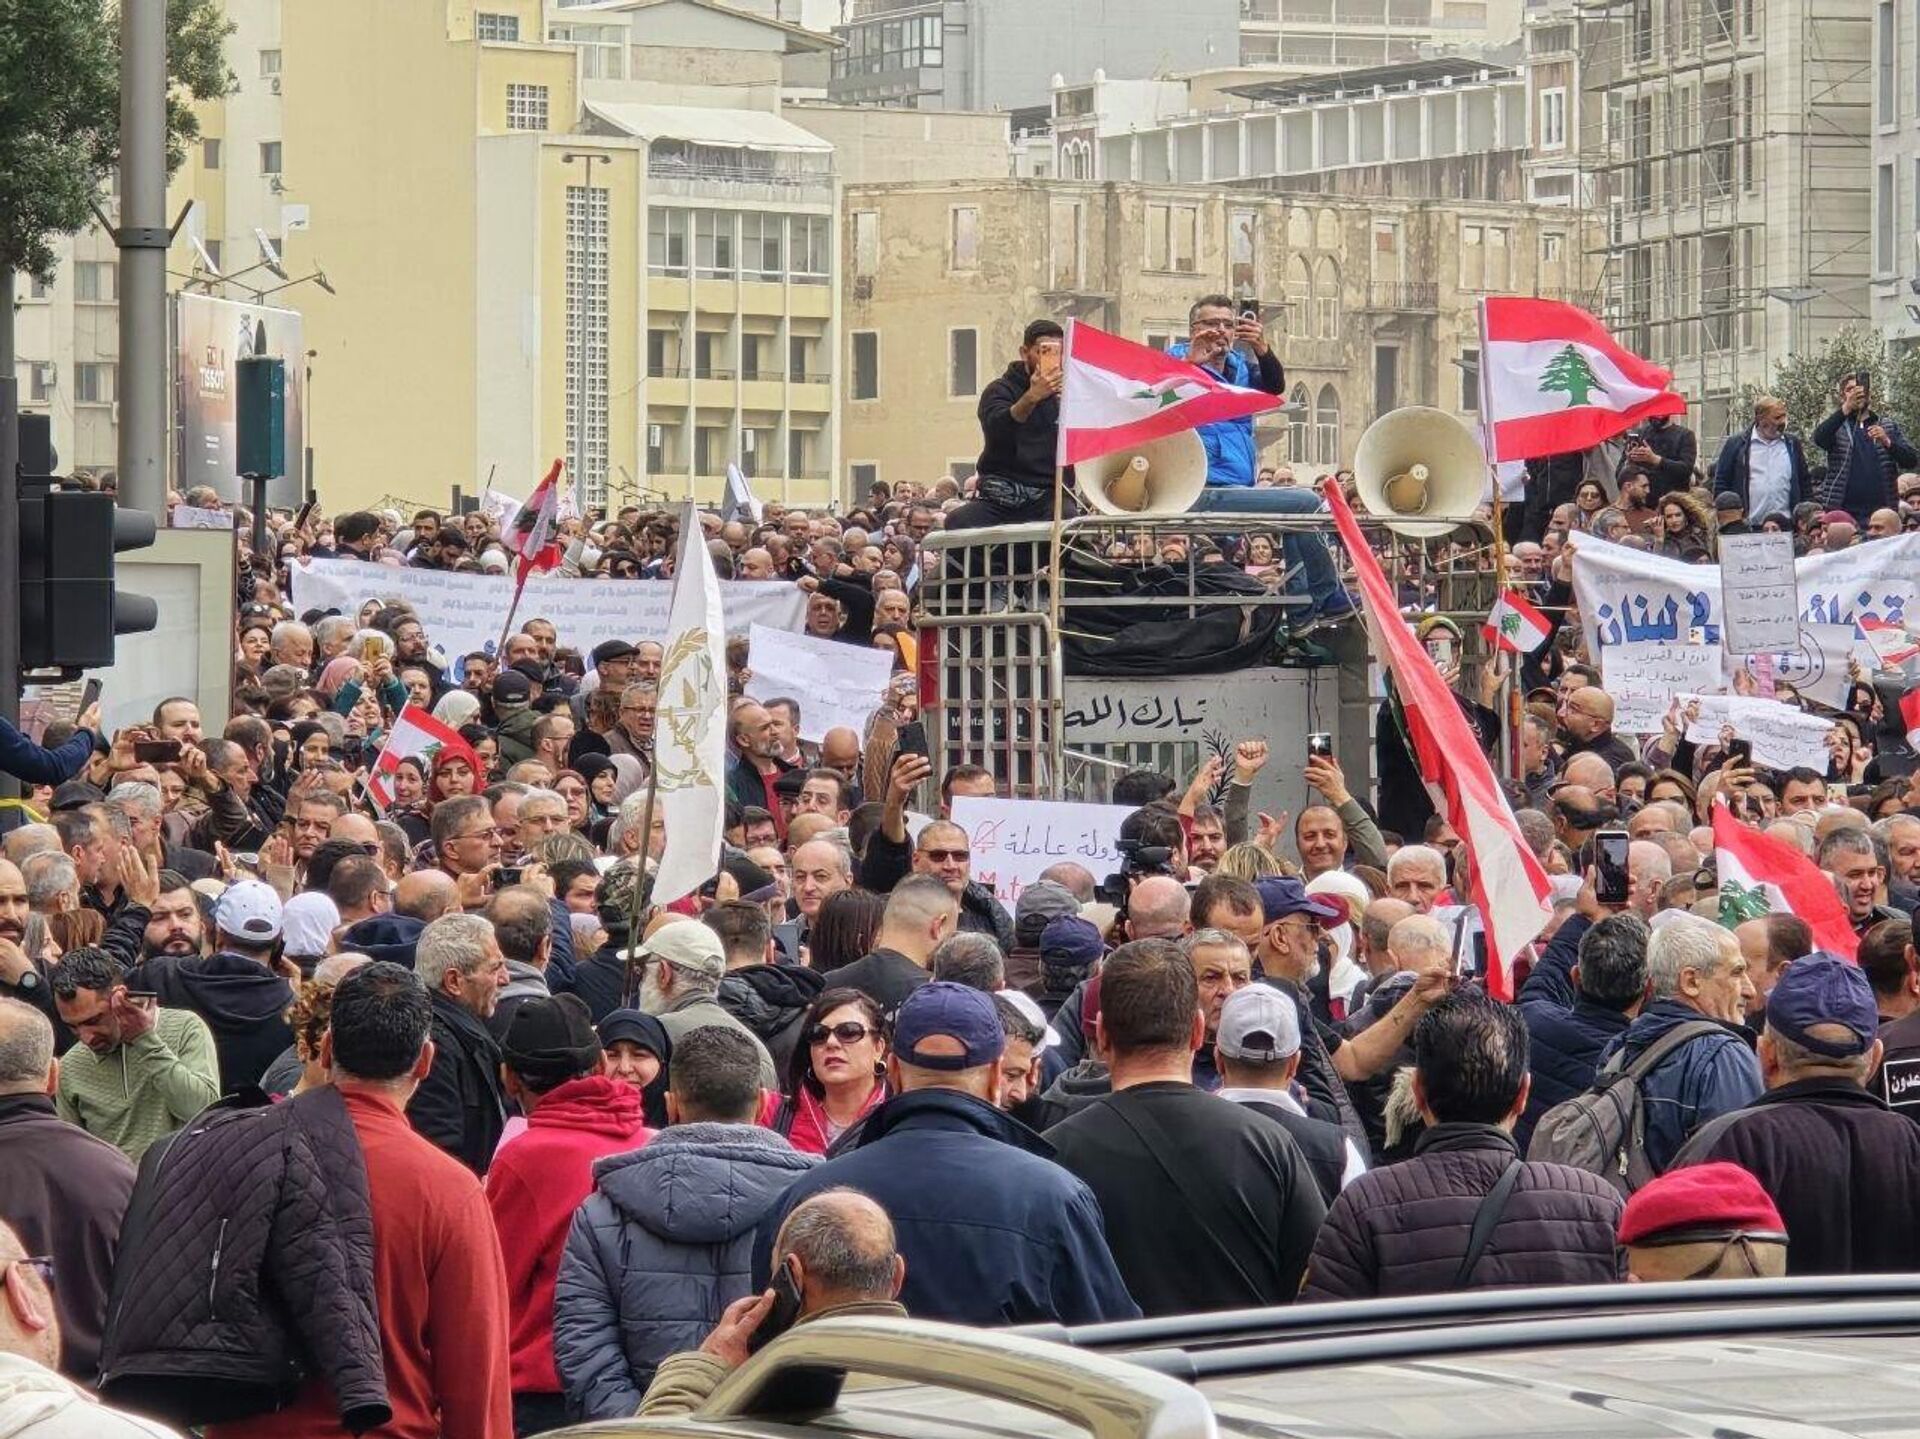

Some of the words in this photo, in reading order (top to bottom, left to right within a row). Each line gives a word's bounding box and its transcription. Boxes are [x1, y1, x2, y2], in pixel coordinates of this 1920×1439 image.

[200, 367, 225, 391] TISSOT
[1597, 593, 1679, 650] لبنان
[1065, 694, 1128, 730] الله
[1131, 696, 1207, 734] تبارك
[1004, 824, 1067, 856] عاملة
[1891, 1073, 1920, 1094] عدون
